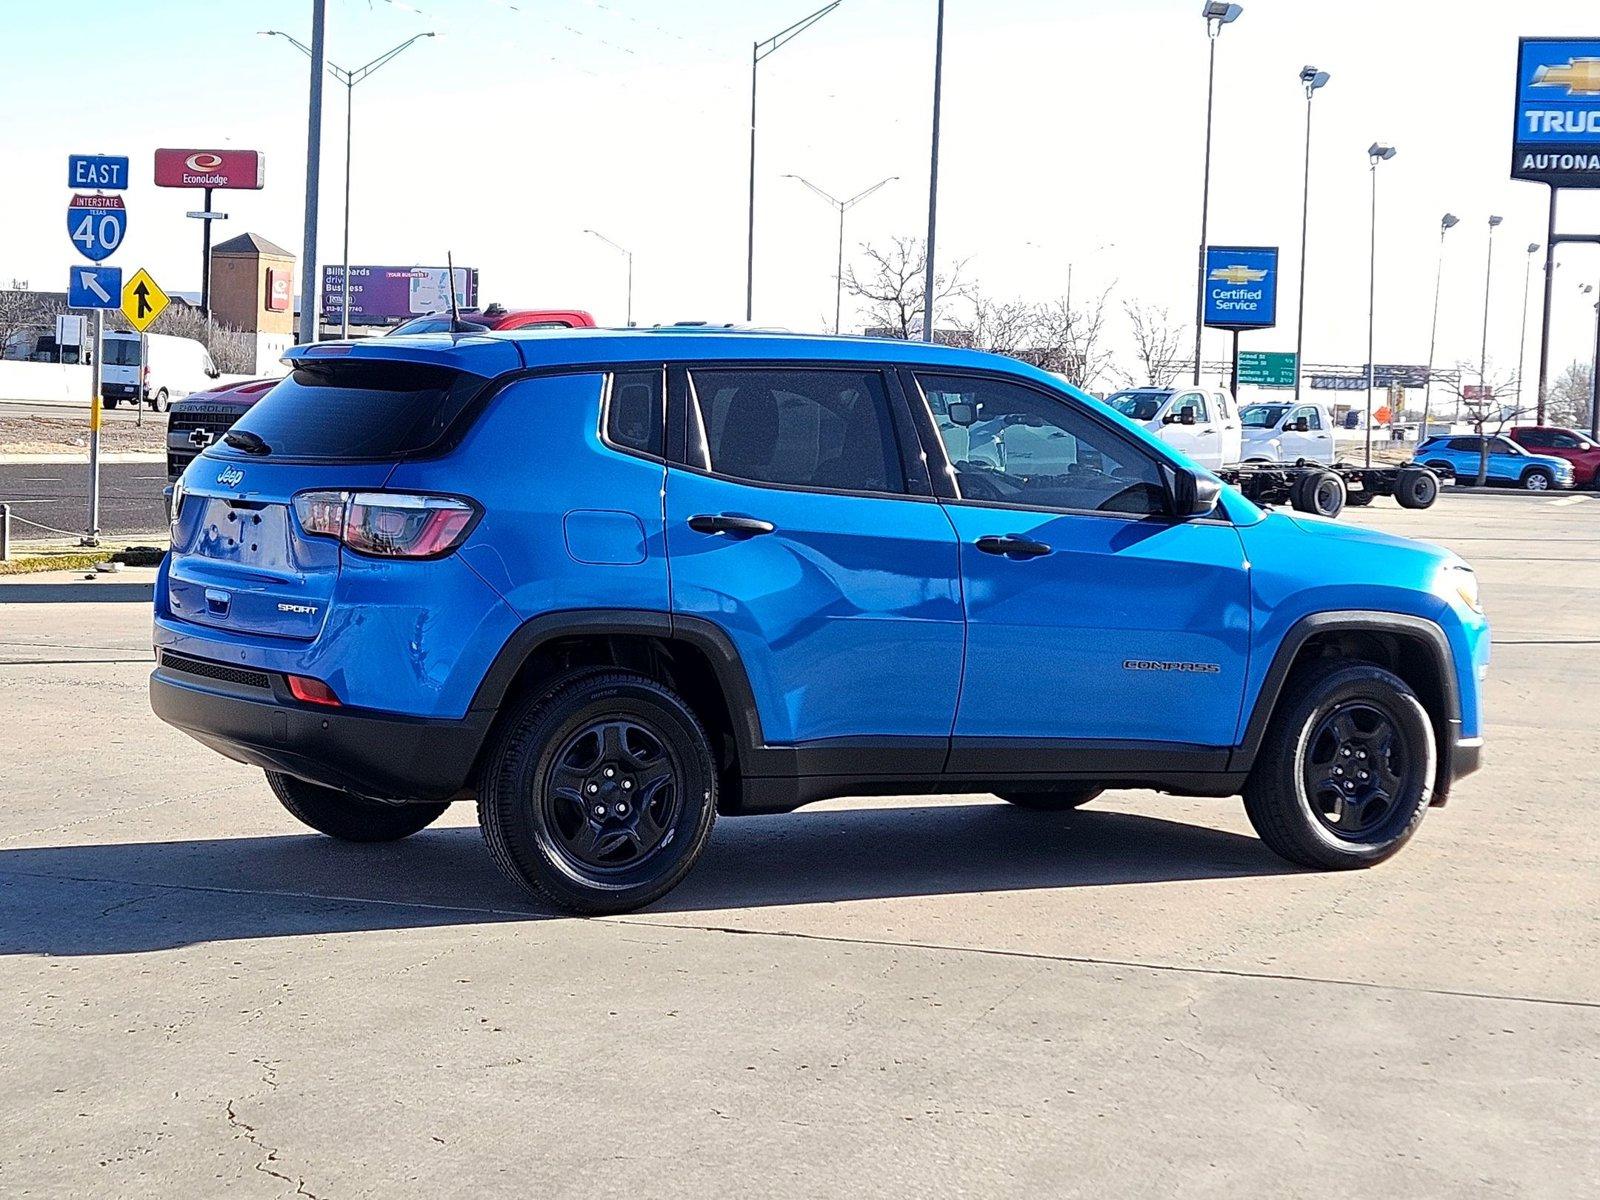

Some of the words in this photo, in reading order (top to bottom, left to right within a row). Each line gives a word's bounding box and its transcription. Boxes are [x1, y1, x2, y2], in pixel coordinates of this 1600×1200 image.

[76, 161, 120, 184] EAST
[183, 173, 228, 185] EconoLodge
[76, 197, 118, 207] INTERSTATE
[73, 215, 120, 250] 40
[325, 284, 363, 292] Busiess
[1212, 289, 1262, 300] Certified
[1216, 300, 1258, 310] Service
[179, 404, 236, 414] CHEVROLET
[217, 464, 244, 487] Jeep
[278, 603, 318, 615] SPORT
[1123, 660, 1220, 673] COMPASS
